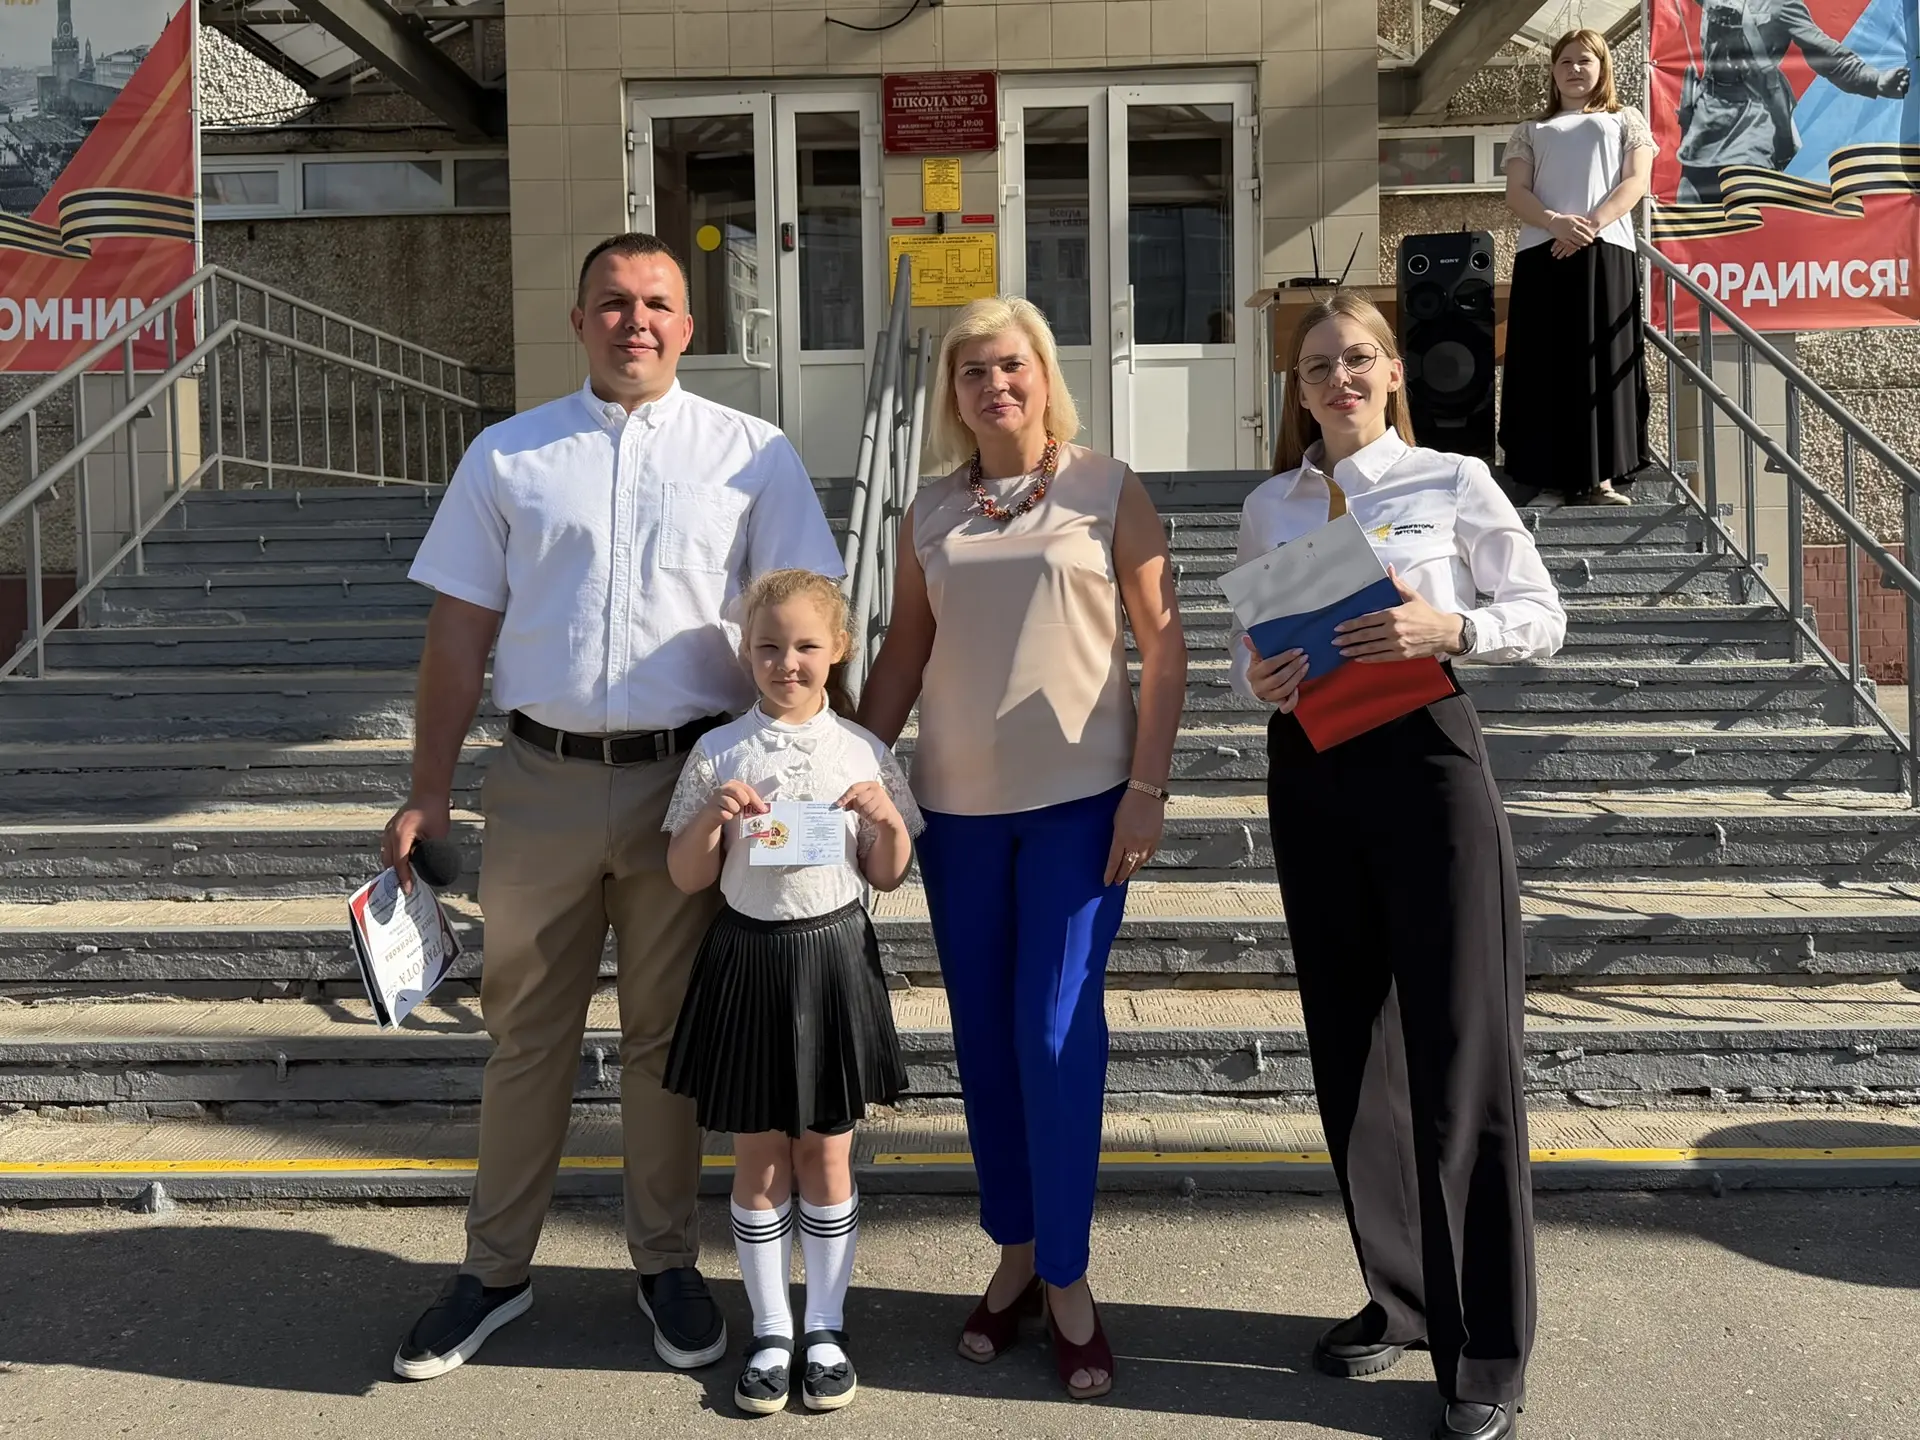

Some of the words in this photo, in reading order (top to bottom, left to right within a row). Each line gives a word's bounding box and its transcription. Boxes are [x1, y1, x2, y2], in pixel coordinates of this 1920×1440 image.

[892, 96, 949, 108] ШКОЛА
[952, 95, 968, 105] №
[970, 94, 988, 105] 20
[934, 120, 956, 128] 07:30
[963, 119, 984, 127] 19:00
[399, 940, 442, 985] ГРАМОТА
